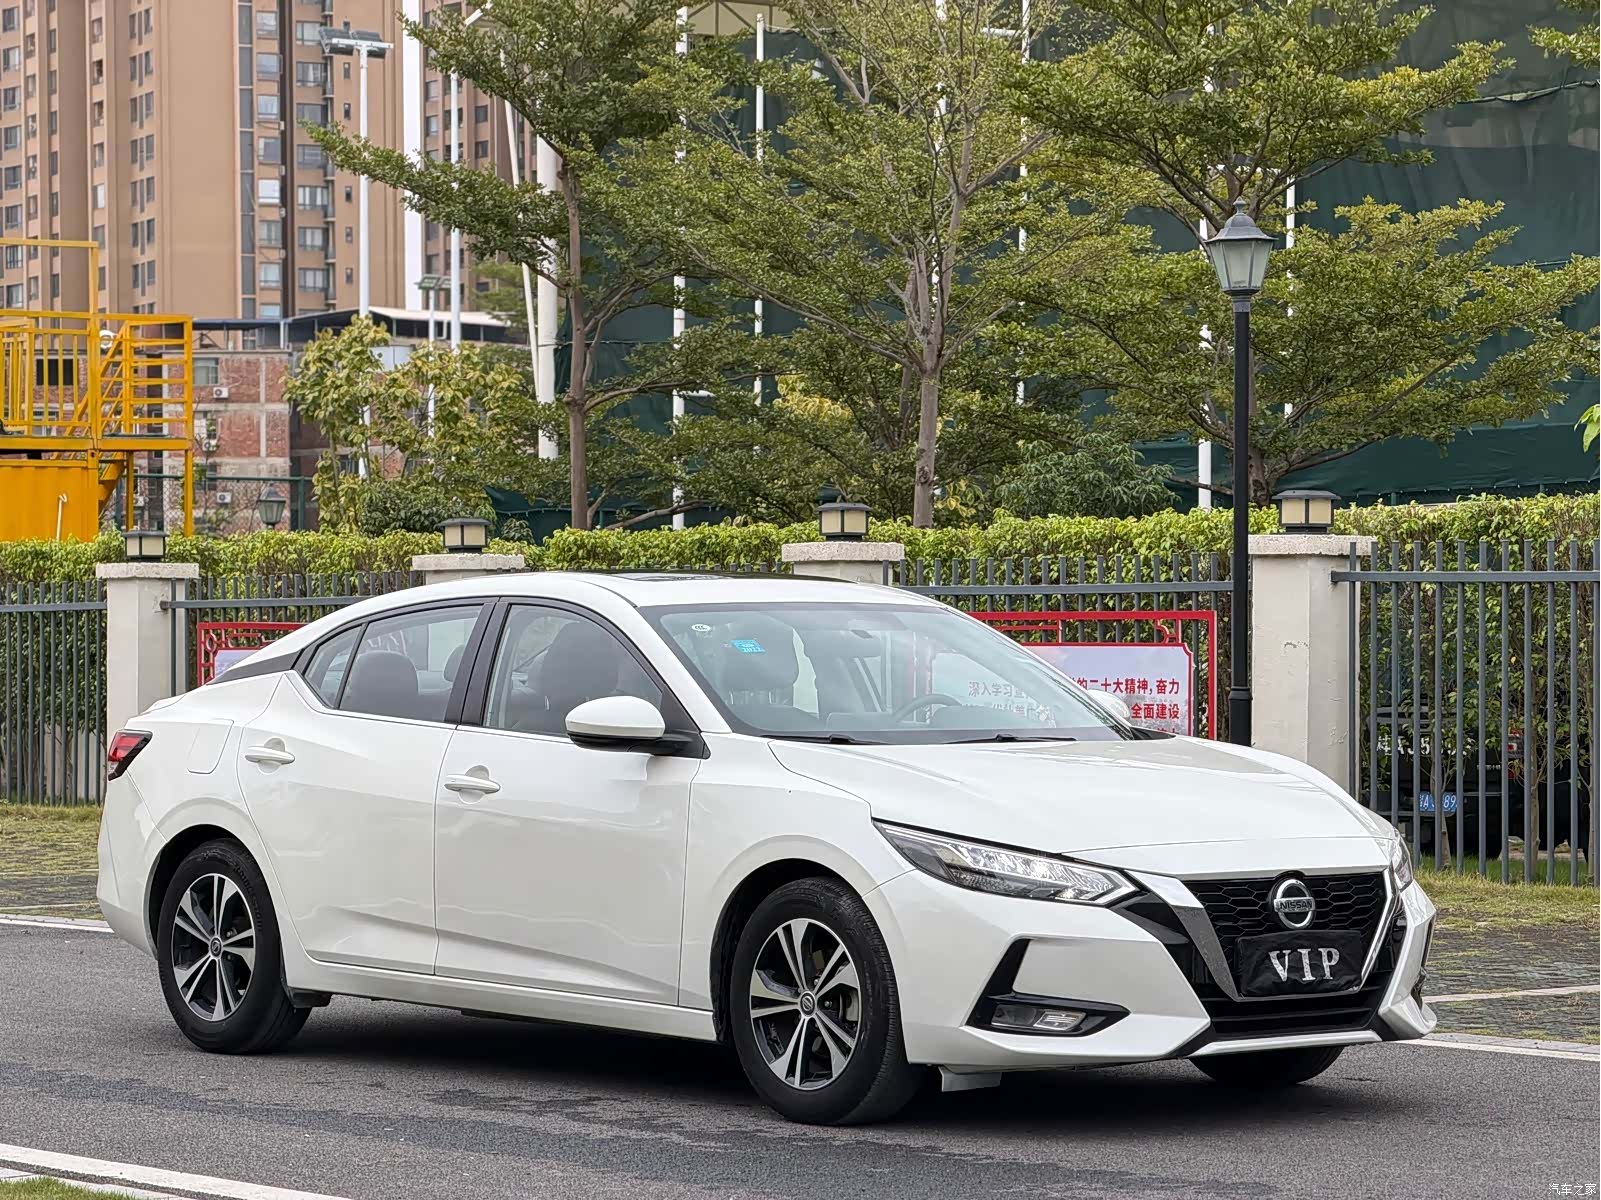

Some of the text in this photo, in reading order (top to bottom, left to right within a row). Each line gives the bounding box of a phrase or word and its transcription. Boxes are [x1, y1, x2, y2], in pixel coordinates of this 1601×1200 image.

[1131, 703, 1180, 719] 全面建设
[1279, 900, 1313, 910] NISSAN
[1267, 947, 1340, 982] VIP
